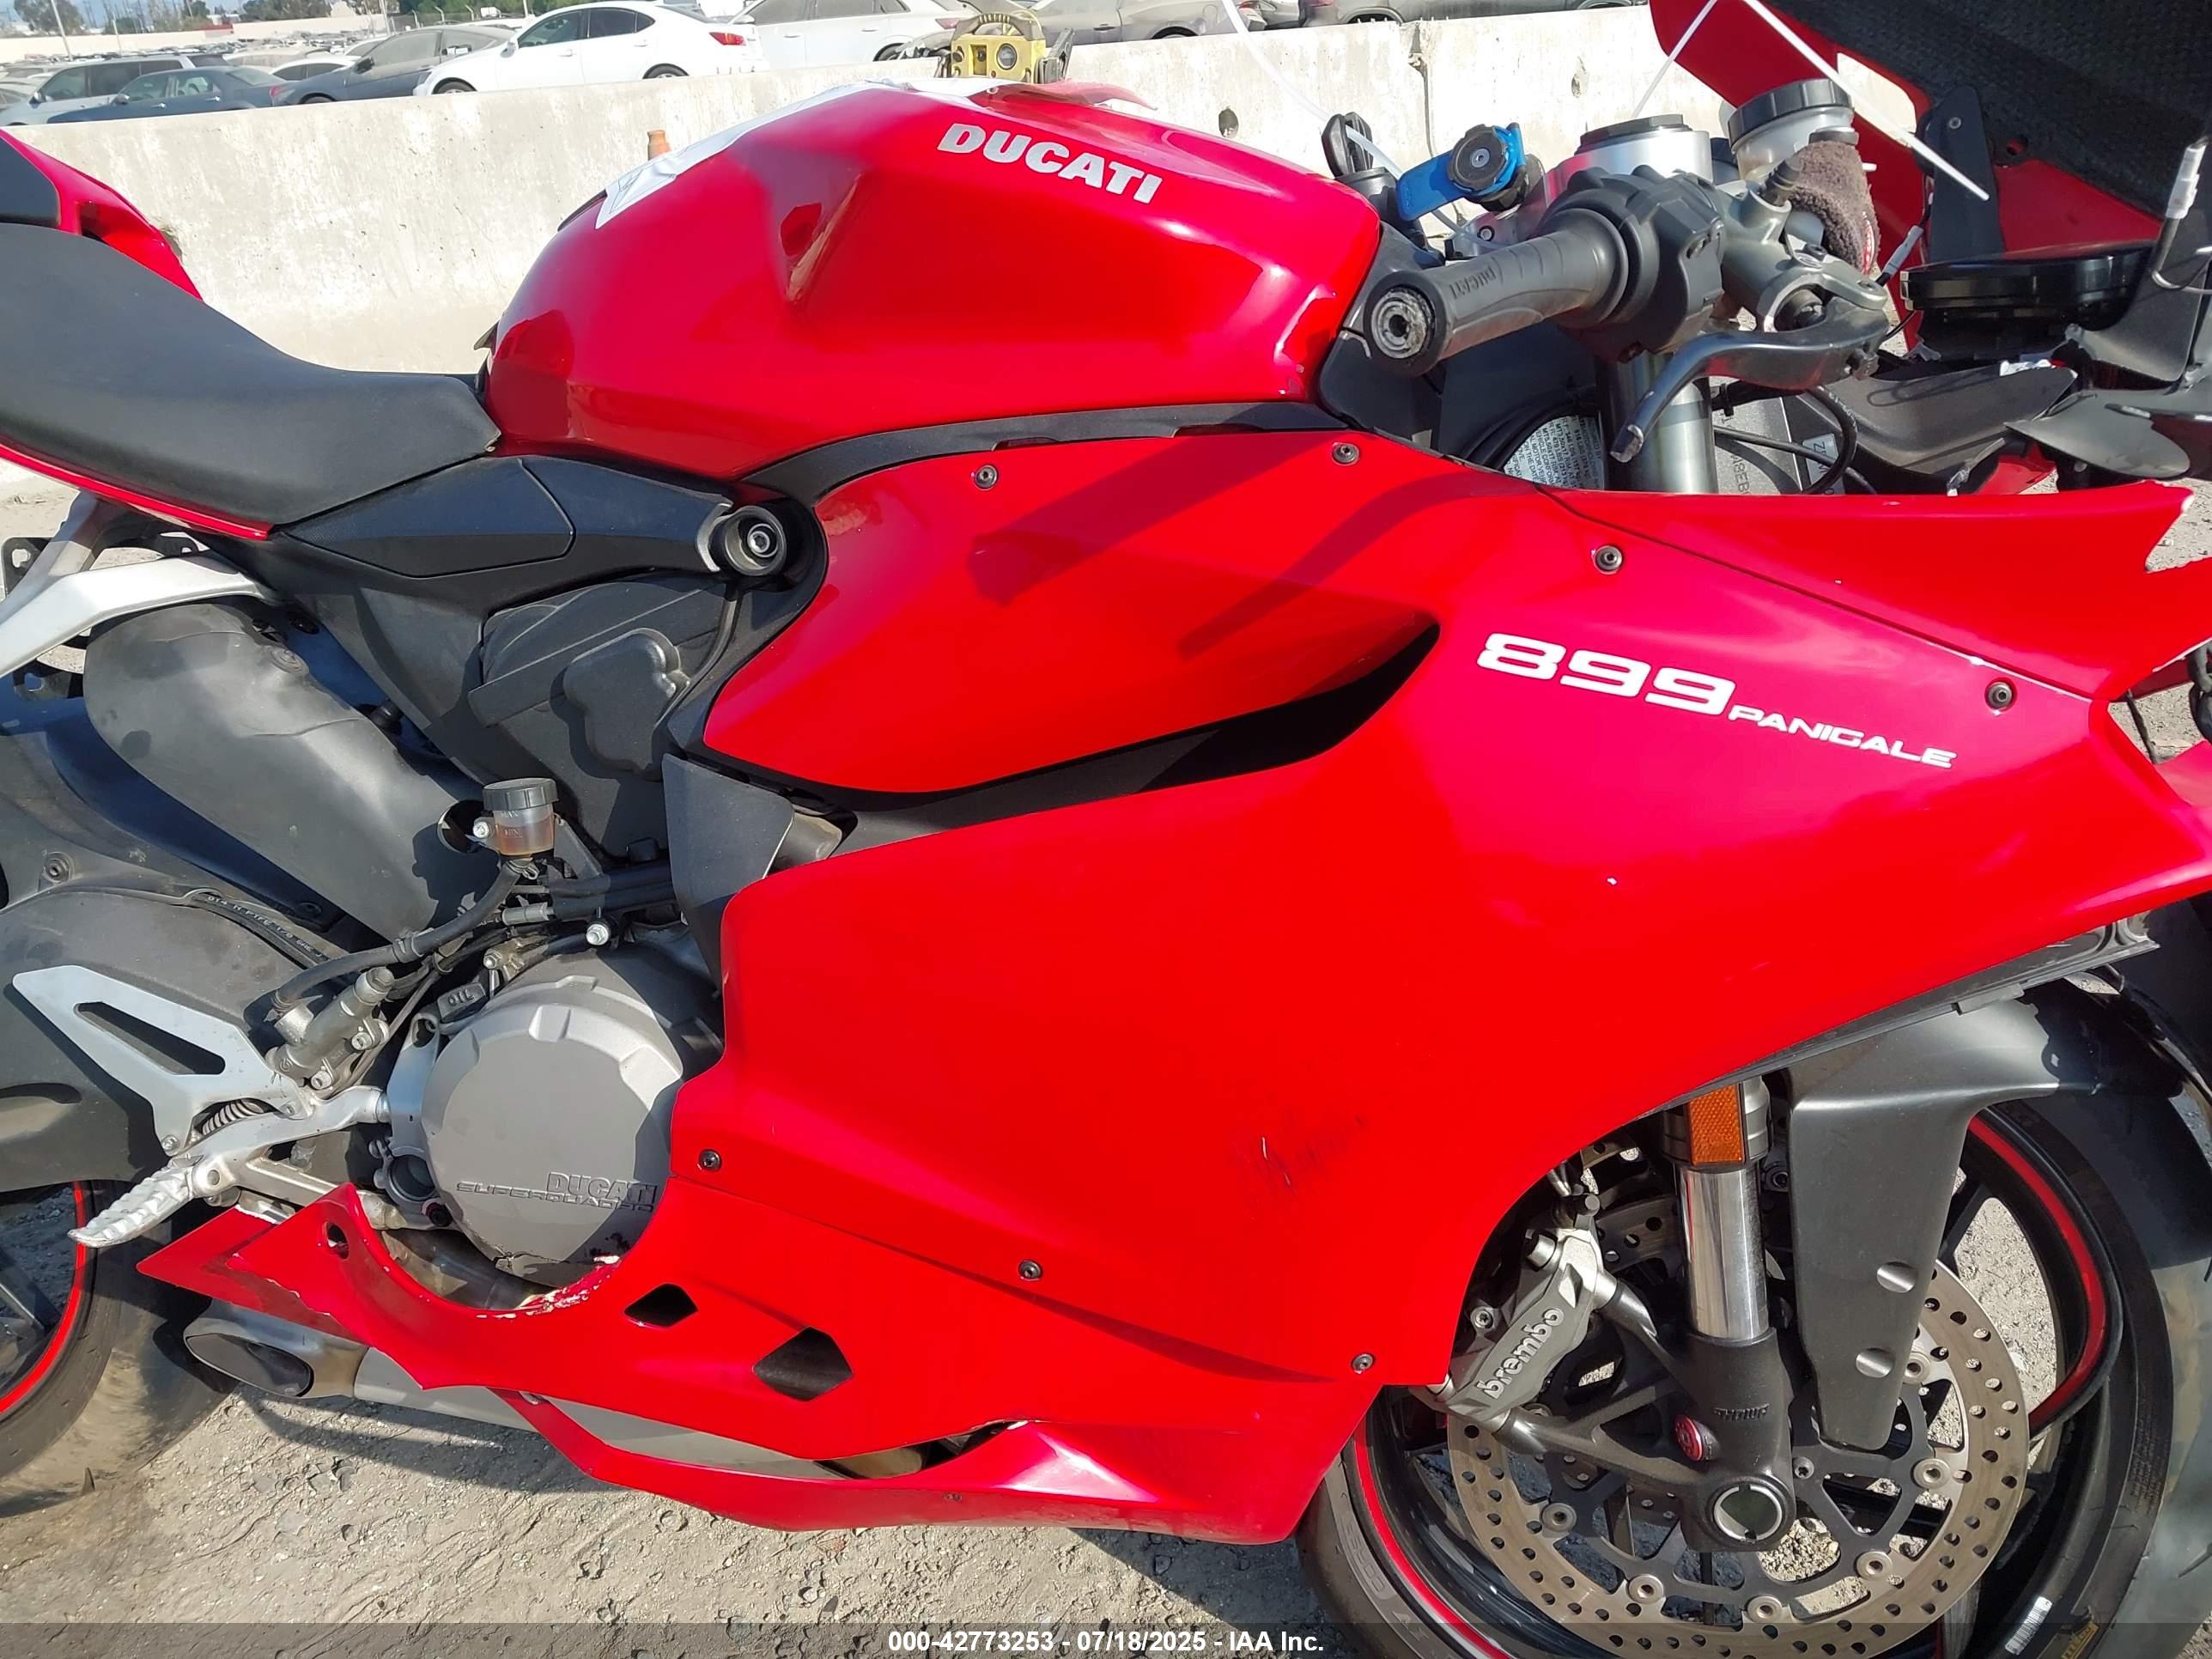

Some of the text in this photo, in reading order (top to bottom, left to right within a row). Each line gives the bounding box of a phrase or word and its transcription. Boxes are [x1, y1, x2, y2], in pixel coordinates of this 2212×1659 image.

[938, 123, 1163, 204] DUCATI
[1526, 452, 1534, 465] THE
[1531, 443, 1542, 467] MOTOR
[1528, 465, 1539, 482] DATE
[1477, 633, 1736, 715] 899
[1728, 704, 1958, 769] PANIGALE
[447, 988, 475, 1006] OIL
[456, 1181, 654, 1212] SUPERQUADRO
[547, 1171, 658, 1208] DUCATI
[1476, 1307, 1565, 1400] brembo
